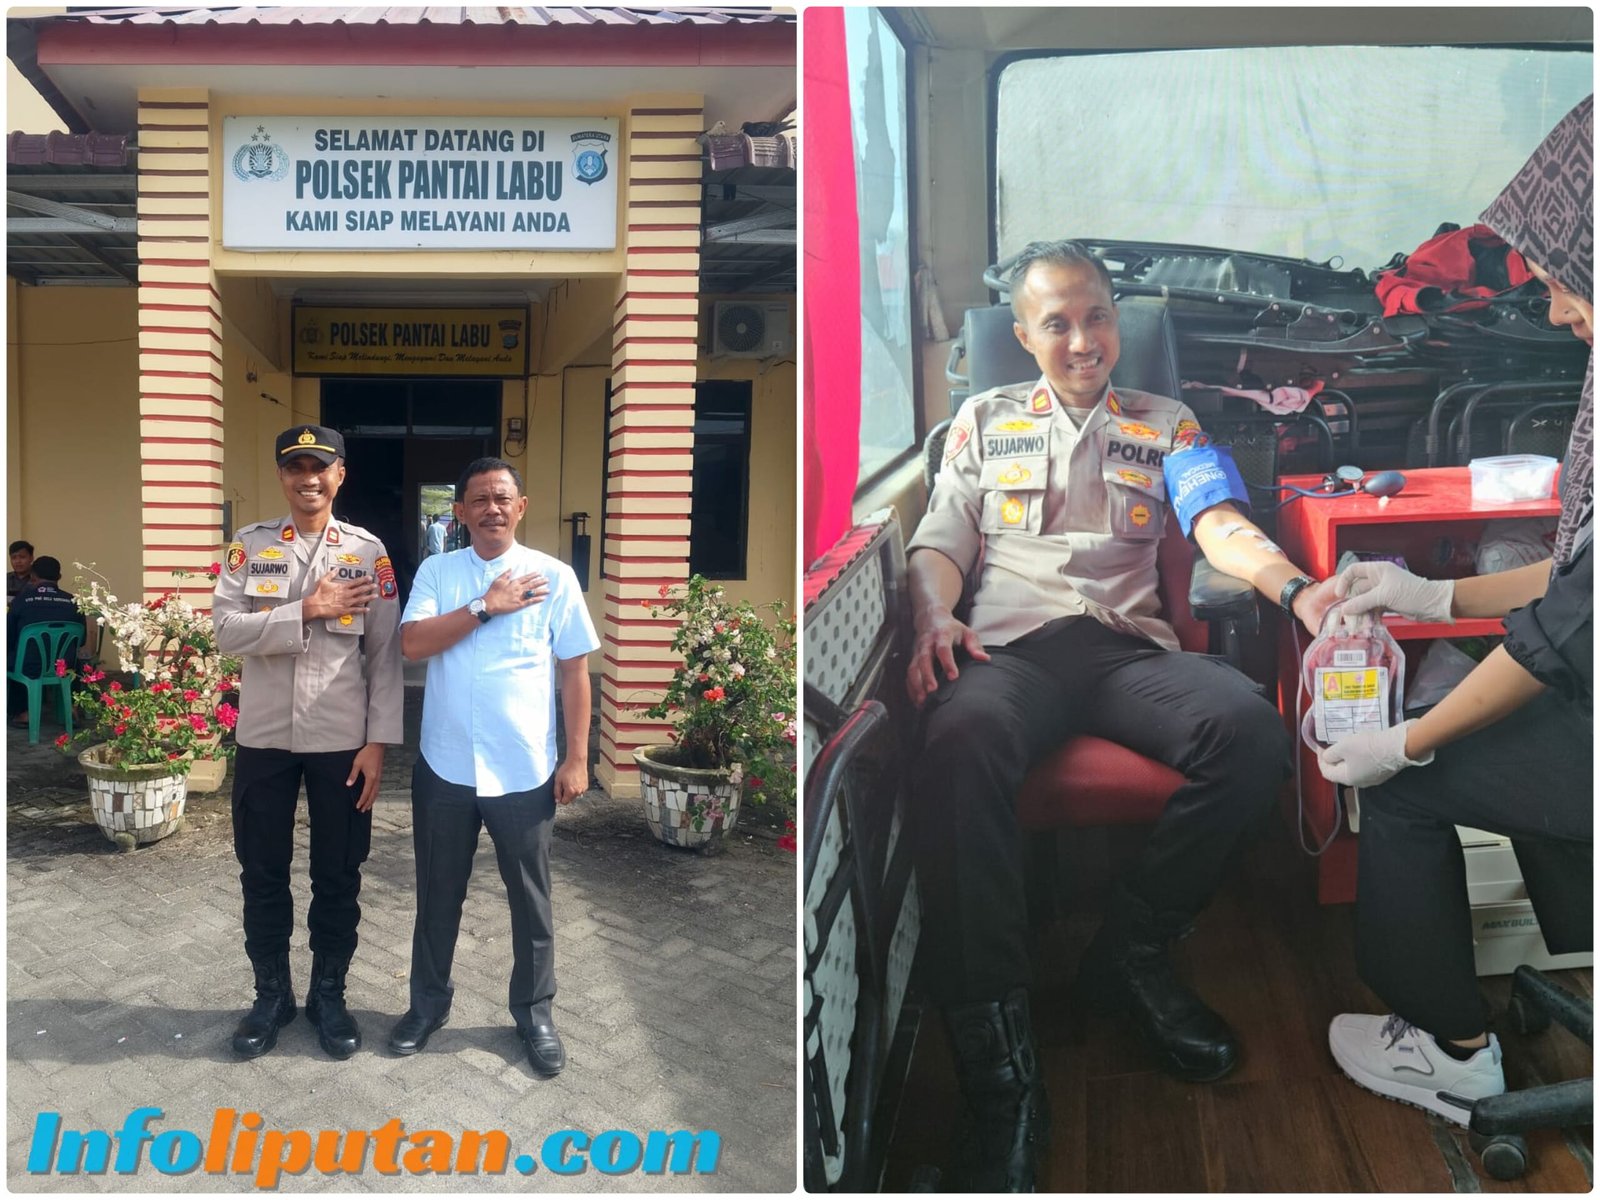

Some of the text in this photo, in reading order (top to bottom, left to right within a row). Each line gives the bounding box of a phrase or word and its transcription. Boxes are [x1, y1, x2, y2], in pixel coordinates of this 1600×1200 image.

[315, 129, 545, 152] SELAMAT DATANG DI
[296, 159, 563, 201] POLSEK PANTAI LABU
[286, 210, 571, 232] KAMI SIAP MELAYANI ANDA
[330, 321, 388, 346] POLSEK
[393, 323, 446, 347] PANTAI
[451, 323, 490, 348] LABU
[988, 436, 1045, 456] SUJARWO
[250, 562, 288, 575] SUJARWO
[1327, 675, 1339, 692] A
